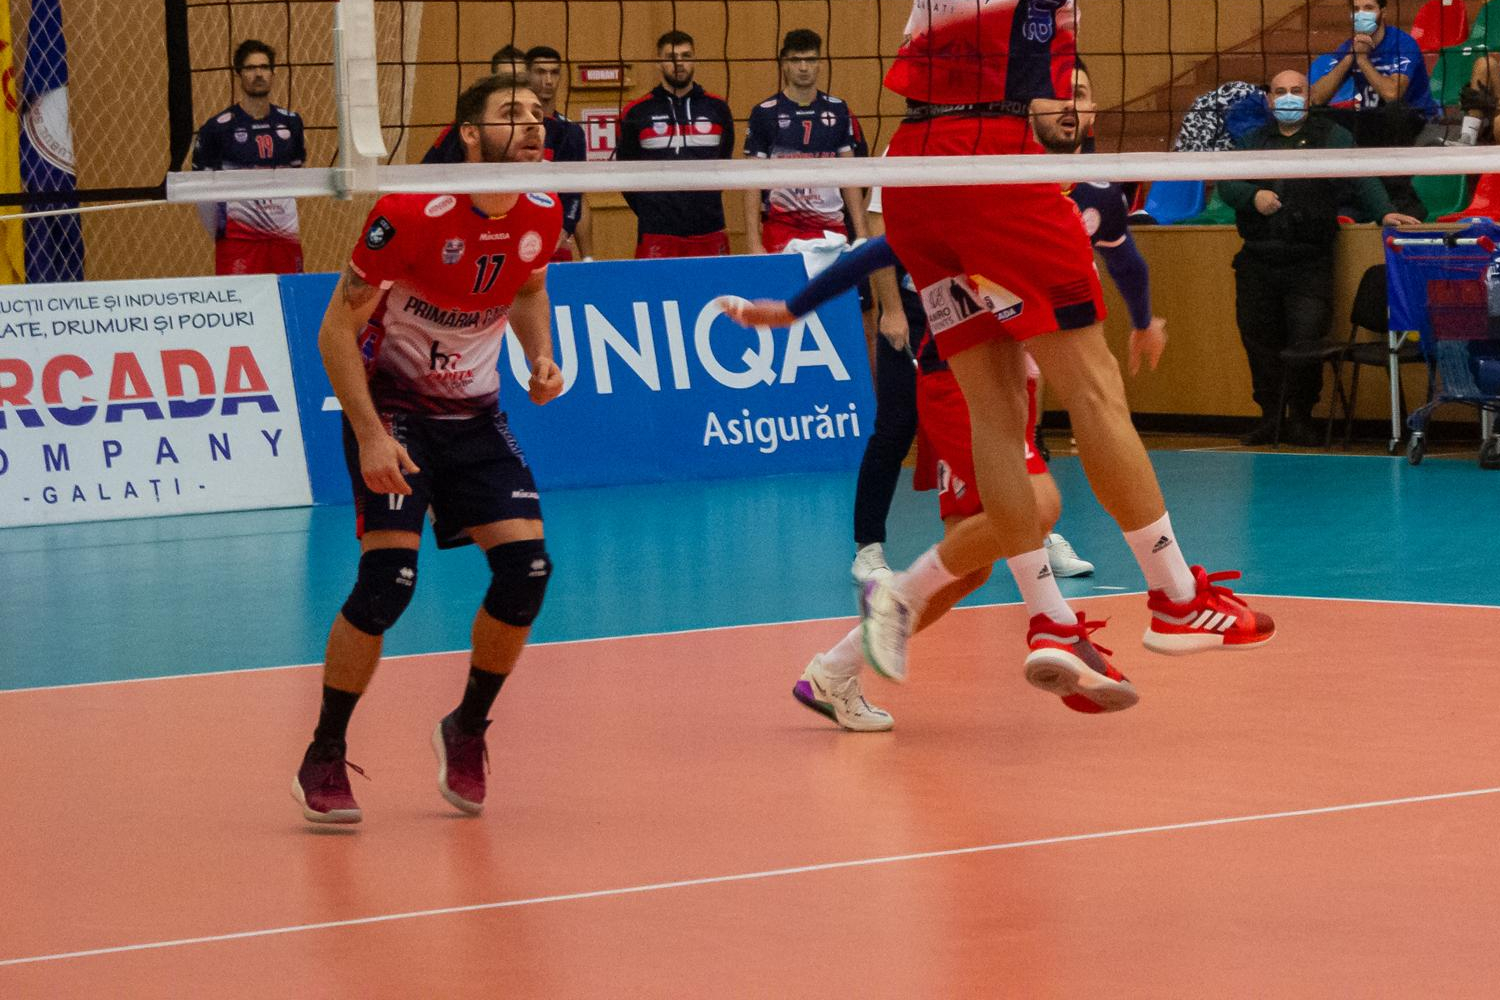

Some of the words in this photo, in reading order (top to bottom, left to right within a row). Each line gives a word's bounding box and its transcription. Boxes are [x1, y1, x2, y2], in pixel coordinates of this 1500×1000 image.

[255, 134, 273, 158] 19
[470, 253, 506, 294] 17
[47, 296, 100, 312] CIVILE
[125, 289, 243, 307] INDUSTRIALE,
[52, 316, 149, 337] DRUMURI
[153, 314, 174, 336] ȘI
[178, 312, 255, 328] PODURI
[505, 294, 852, 398] UNIQA
[703, 402, 861, 454] Asigurări
